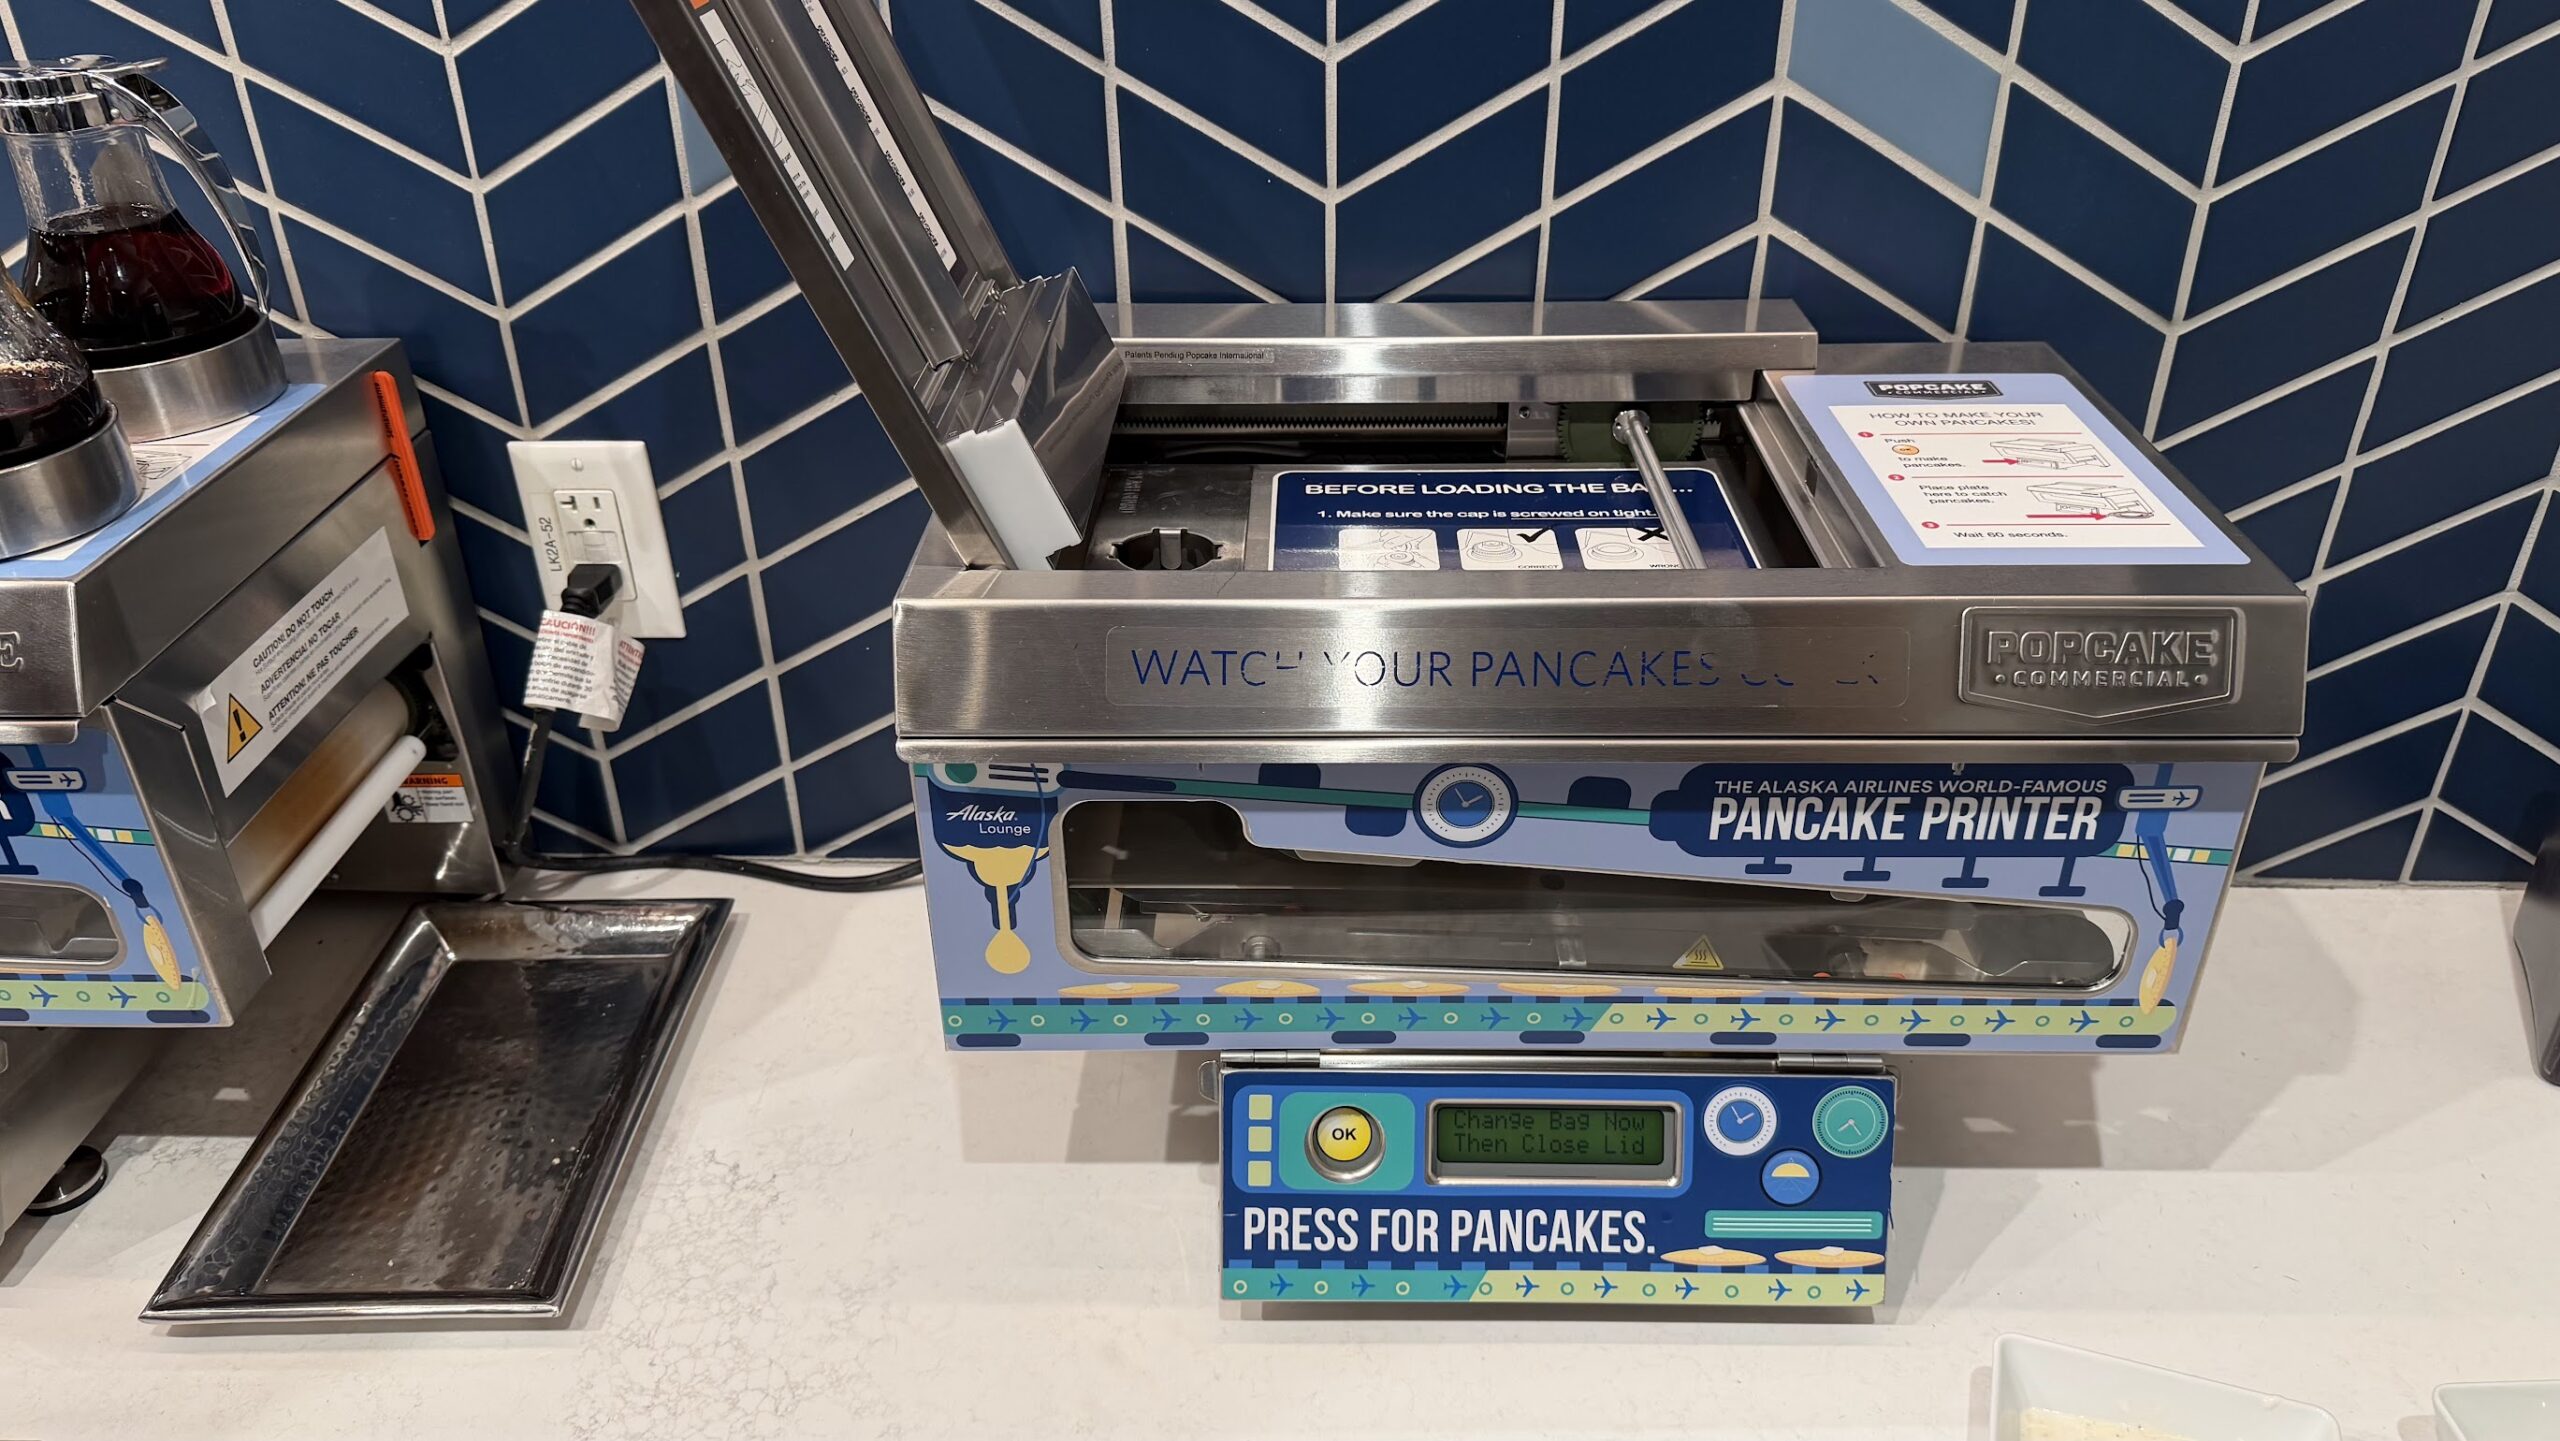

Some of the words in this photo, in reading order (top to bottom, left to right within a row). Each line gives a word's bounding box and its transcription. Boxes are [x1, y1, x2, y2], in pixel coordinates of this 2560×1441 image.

[1124, 351, 1152, 359] Patents
[1154, 351, 1184, 360] Pending
[1186, 351, 1217, 360] Popcake
[1219, 351, 1264, 359] International
[1878, 383, 1987, 391] POPCAKE
[1305, 484, 1416, 495] BEFORE
[1421, 483, 1545, 495] LOADING
[1549, 483, 1607, 494] THE
[1610, 483, 1694, 494] BA...
[1336, 510, 1382, 518] Make
[1426, 510, 1454, 518] the
[1457, 511, 1490, 520] cap
[1492, 510, 1507, 518] is
[1510, 509, 1584, 518] screwed
[1588, 510, 1609, 518] on
[1613, 509, 1658, 519] tight.
[538, 516, 562, 572] LK2A-52
[252, 634, 286, 668] CAUTION!
[285, 624, 296, 638] DO
[296, 609, 311, 627] NOT
[311, 588, 334, 612] TOUCH
[308, 633, 318, 647] NO
[318, 611, 342, 637] TOCAR
[306, 667, 316, 683] NE
[316, 655, 329, 673] PAS
[329, 626, 360, 659] TOUCHER
[1987, 631, 2219, 666] POPCAKE
[1472, 650, 1720, 687] PANCAKES
[2012, 670, 2190, 687] COMMERCIAL
[1715, 780, 1754, 794] THE
[1757, 780, 1838, 794] ALASKA
[1843, 780, 1933, 794] AIRLINES
[1939, 780, 2107, 793] WORLD-FAMOUS
[946, 804, 1016, 823] Alaska
[1709, 796, 1911, 841] PANCAKE
[1919, 796, 2102, 840] PRINTER
[979, 823, 1031, 836] Lounge
[1454, 1110, 1535, 1130] Change
[1550, 1112, 1590, 1130] Bag
[1605, 1112, 1645, 1131] Now
[1332, 1128, 1357, 1141] OK
[1454, 1134, 1508, 1153] Then
[1522, 1134, 1590, 1154] Close
[1605, 1135, 1645, 1154] Lid
[1243, 1207, 1359, 1252] PRESS
[1370, 1208, 1439, 1253] FOR
[1450, 1209, 1656, 1254] PANCAKES.
